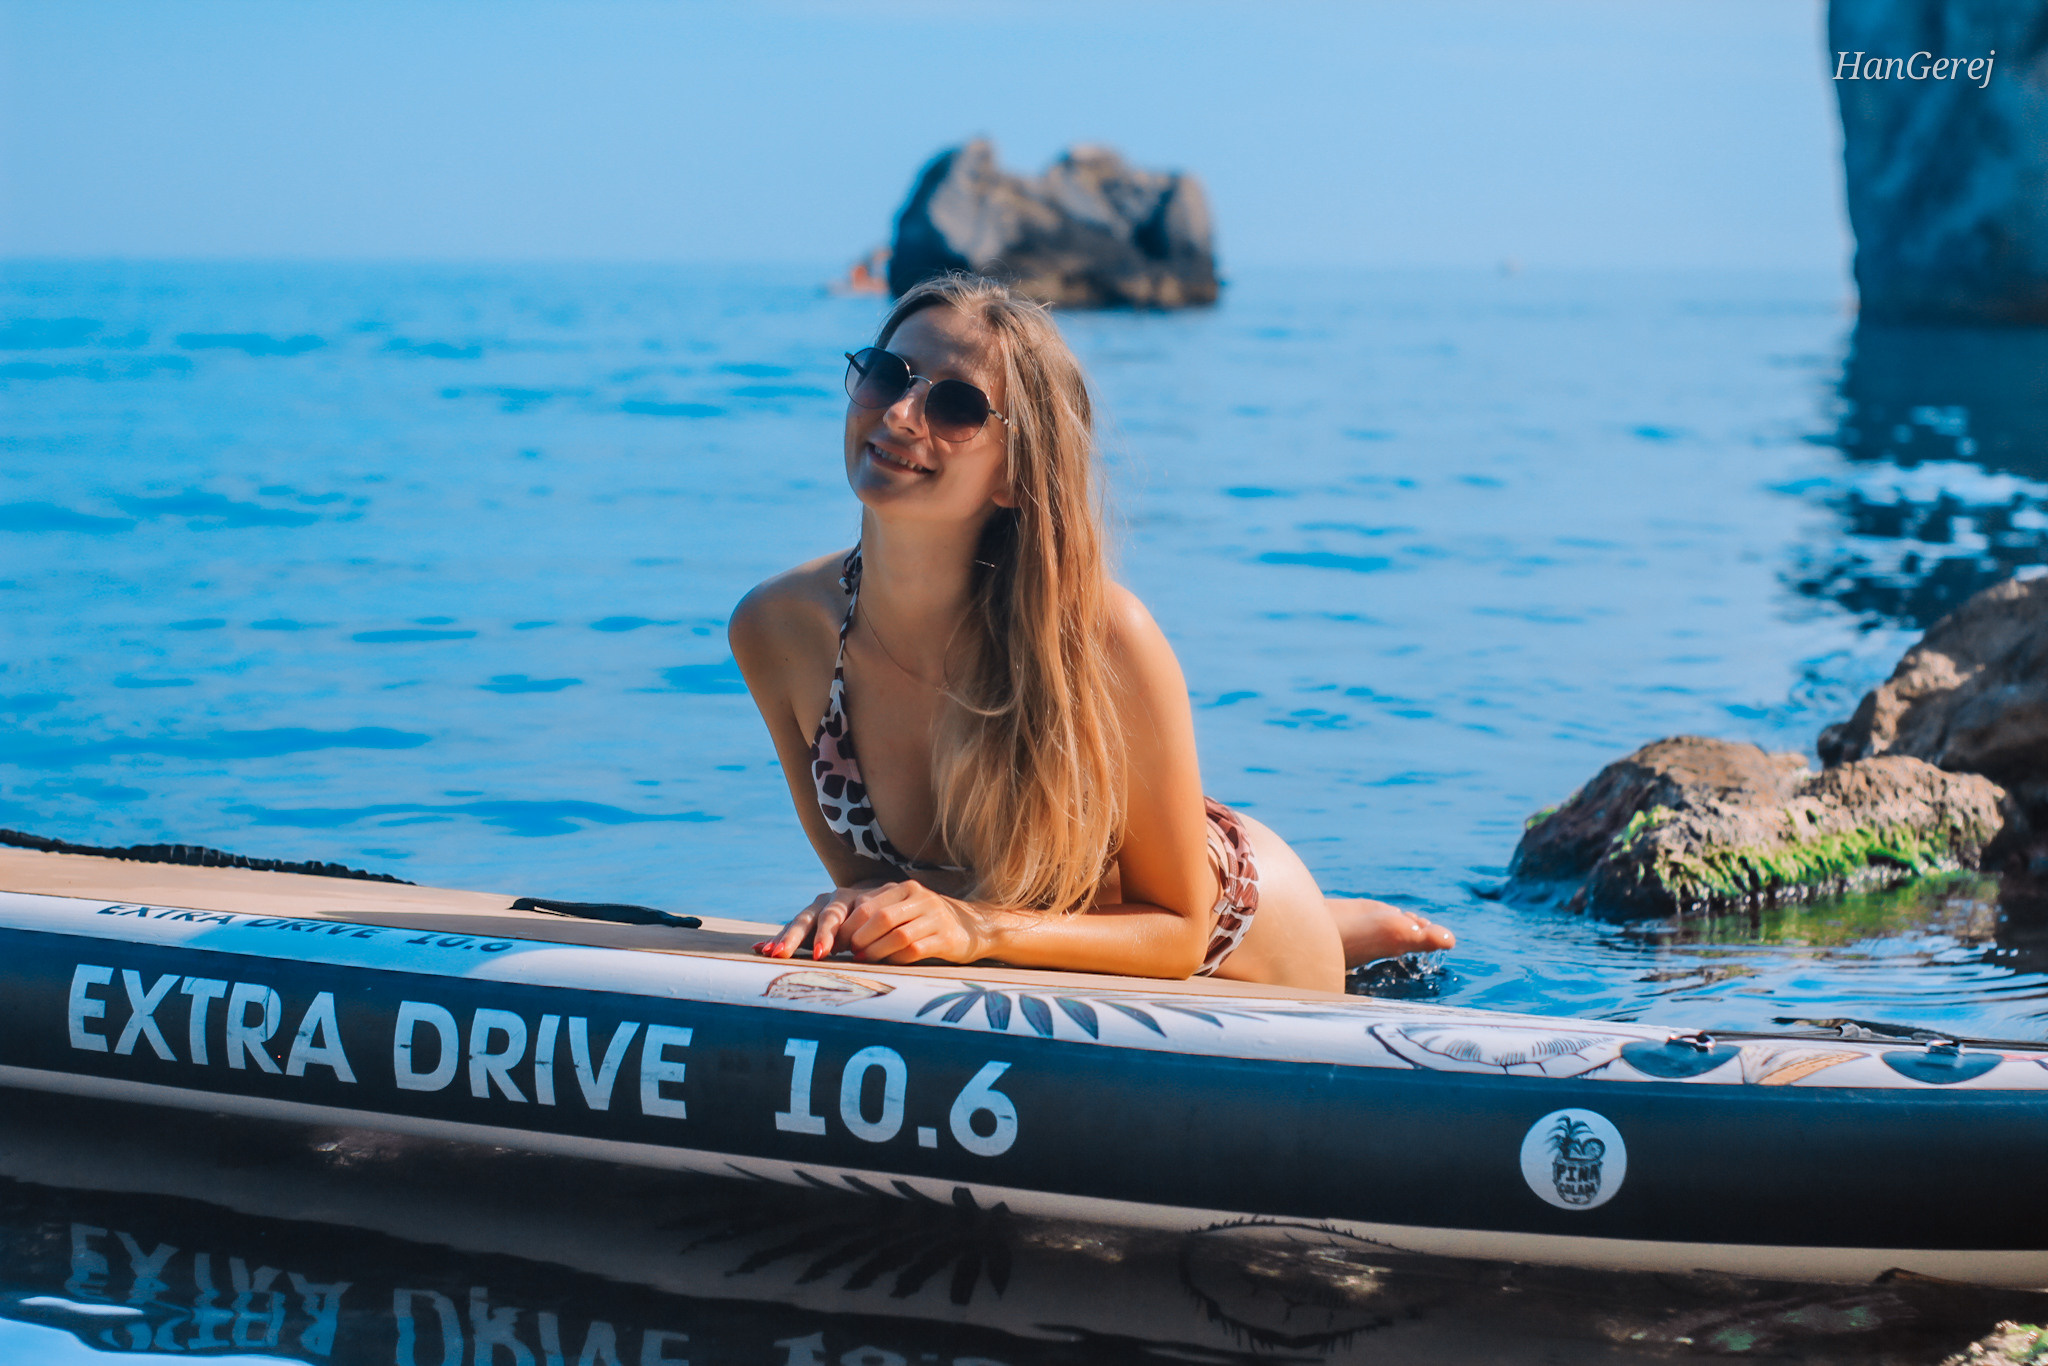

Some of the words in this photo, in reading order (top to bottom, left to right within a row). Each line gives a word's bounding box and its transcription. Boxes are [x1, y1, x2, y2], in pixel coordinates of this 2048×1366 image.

[97, 904, 238, 925] EXTRA
[244, 918, 389, 938] DRIVE
[405, 932, 513, 952] 10.6
[68, 963, 357, 1084] EXTRA
[394, 1000, 693, 1119] DRIVE
[775, 1038, 1018, 1157] 10.6
